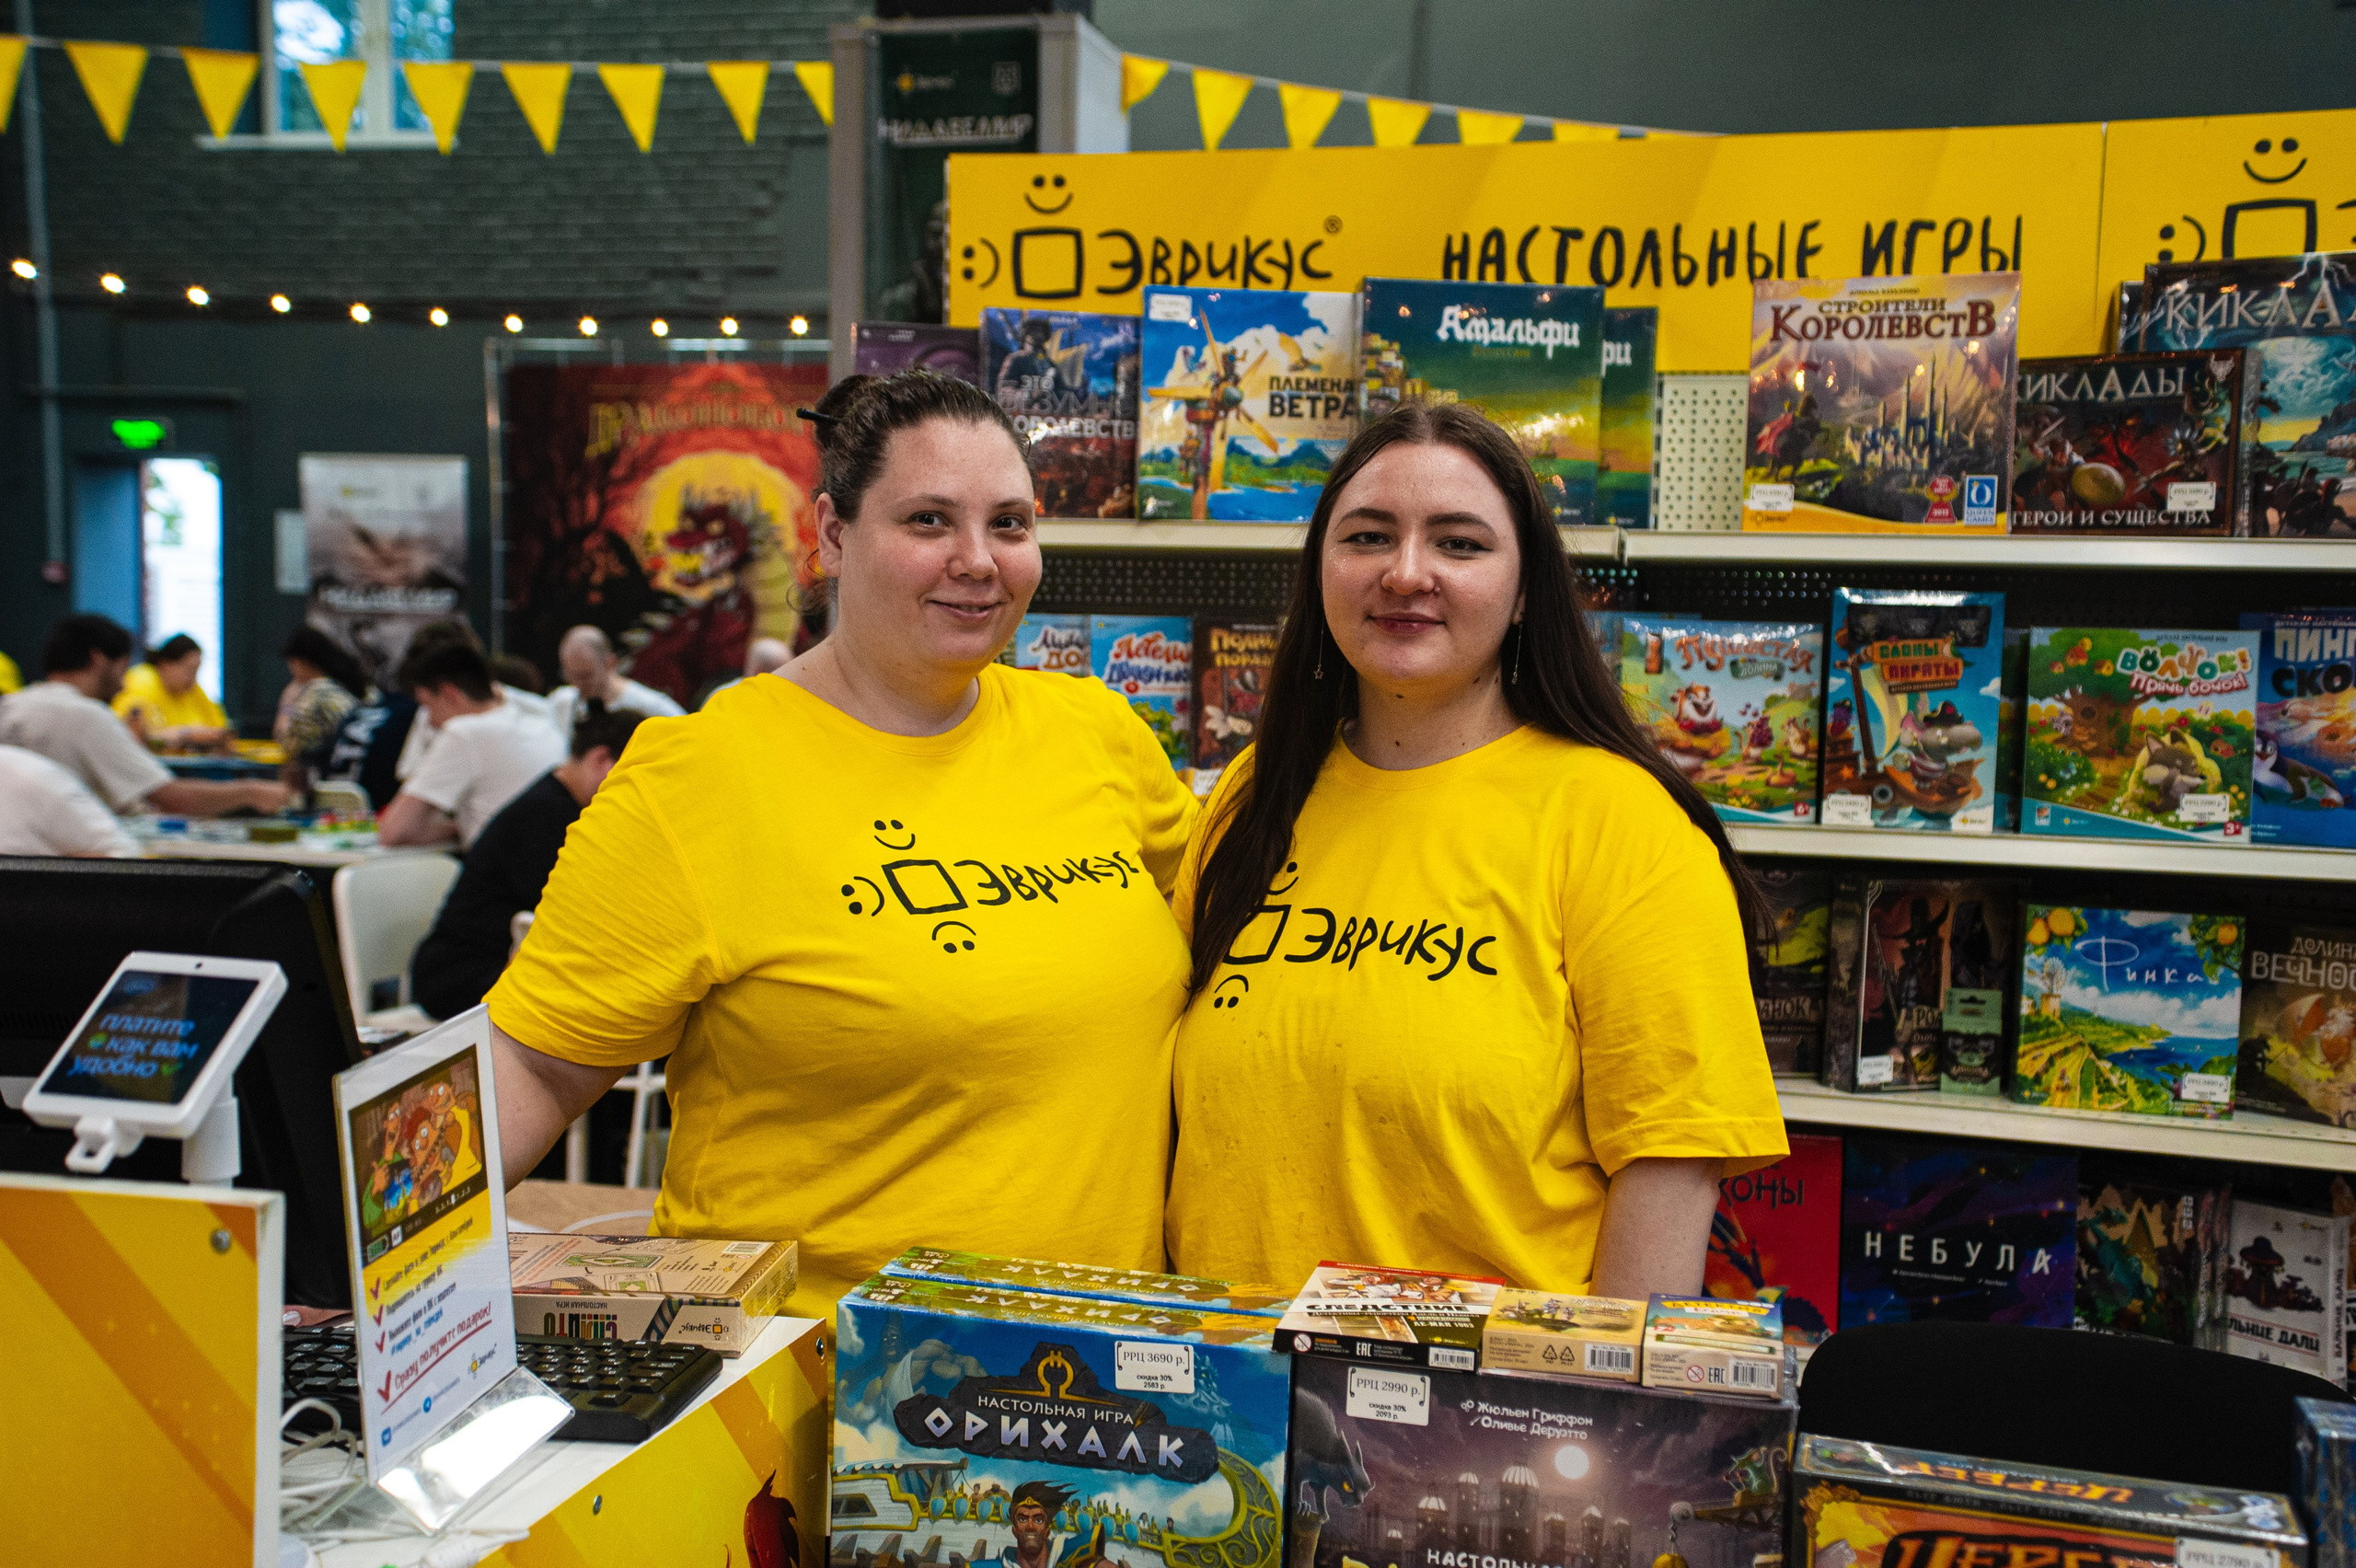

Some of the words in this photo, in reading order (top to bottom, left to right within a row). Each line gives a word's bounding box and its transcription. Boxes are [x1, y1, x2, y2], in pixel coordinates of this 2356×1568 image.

[1442, 220, 1823, 287] НАСТОЛЬНЫЕ
[1863, 215, 2022, 275] ИГРЫ
[1819, 298, 1946, 315] СТРОИТЕЛИ
[2164, 279, 2356, 329] КИКЛА
[1437, 304, 1580, 360] Амальфи
[1269, 375, 1356, 393] ПЛЕМЕНА
[1269, 394, 1359, 420] ВЕТРА
[2013, 510, 2073, 527] ГЕРОИ
[2080, 511, 2094, 526] И
[2102, 510, 2211, 528] СУЩЕСТВА
[953, 850, 1139, 906] Эврикус
[1284, 906, 1497, 981] Эврикус
[2292, 937, 2356, 959] ДОЛИН
[2074, 936, 2204, 992] Финка
[1865, 1230, 2053, 1276] НЕБУЛА
[556, 1300, 571, 1309] ИГРА
[1306, 1303, 1471, 1312] СЛЕДСТВИЕ
[682, 1322, 712, 1334] Эврикус
[394, 1361, 418, 1389] Сразу
[420, 1327, 456, 1366] получите
[456, 1301, 491, 1335] подарок!
[1124, 1352, 1145, 1363] РРЦ
[1148, 1353, 1173, 1364] 3690
[1176, 1356, 1185, 1366] р.
[1144, 1381, 1160, 1389] 2583
[1708, 1366, 1726, 1384] EAC
[1357, 1378, 1380, 1391] РРЦ
[1381, 1380, 1408, 1394] 2990
[1411, 1385, 1421, 1397] р.
[977, 1395, 1086, 1420] НАСТОЛЬНАЯ
[1093, 1409, 1135, 1424] ИГРА
[1369, 1402, 1392, 1412] скидка
[1392, 1404, 1406, 1412] 30%
[1375, 1411, 1392, 1419] 2093
[1477, 1401, 1530, 1419] Жюльен
[1532, 1408, 1593, 1427] Гриффон
[924, 1407, 1185, 1468] ОРИХАЛК
[1481, 1415, 1527, 1433] Оливье
[1530, 1422, 1588, 1441] Деруэтто
